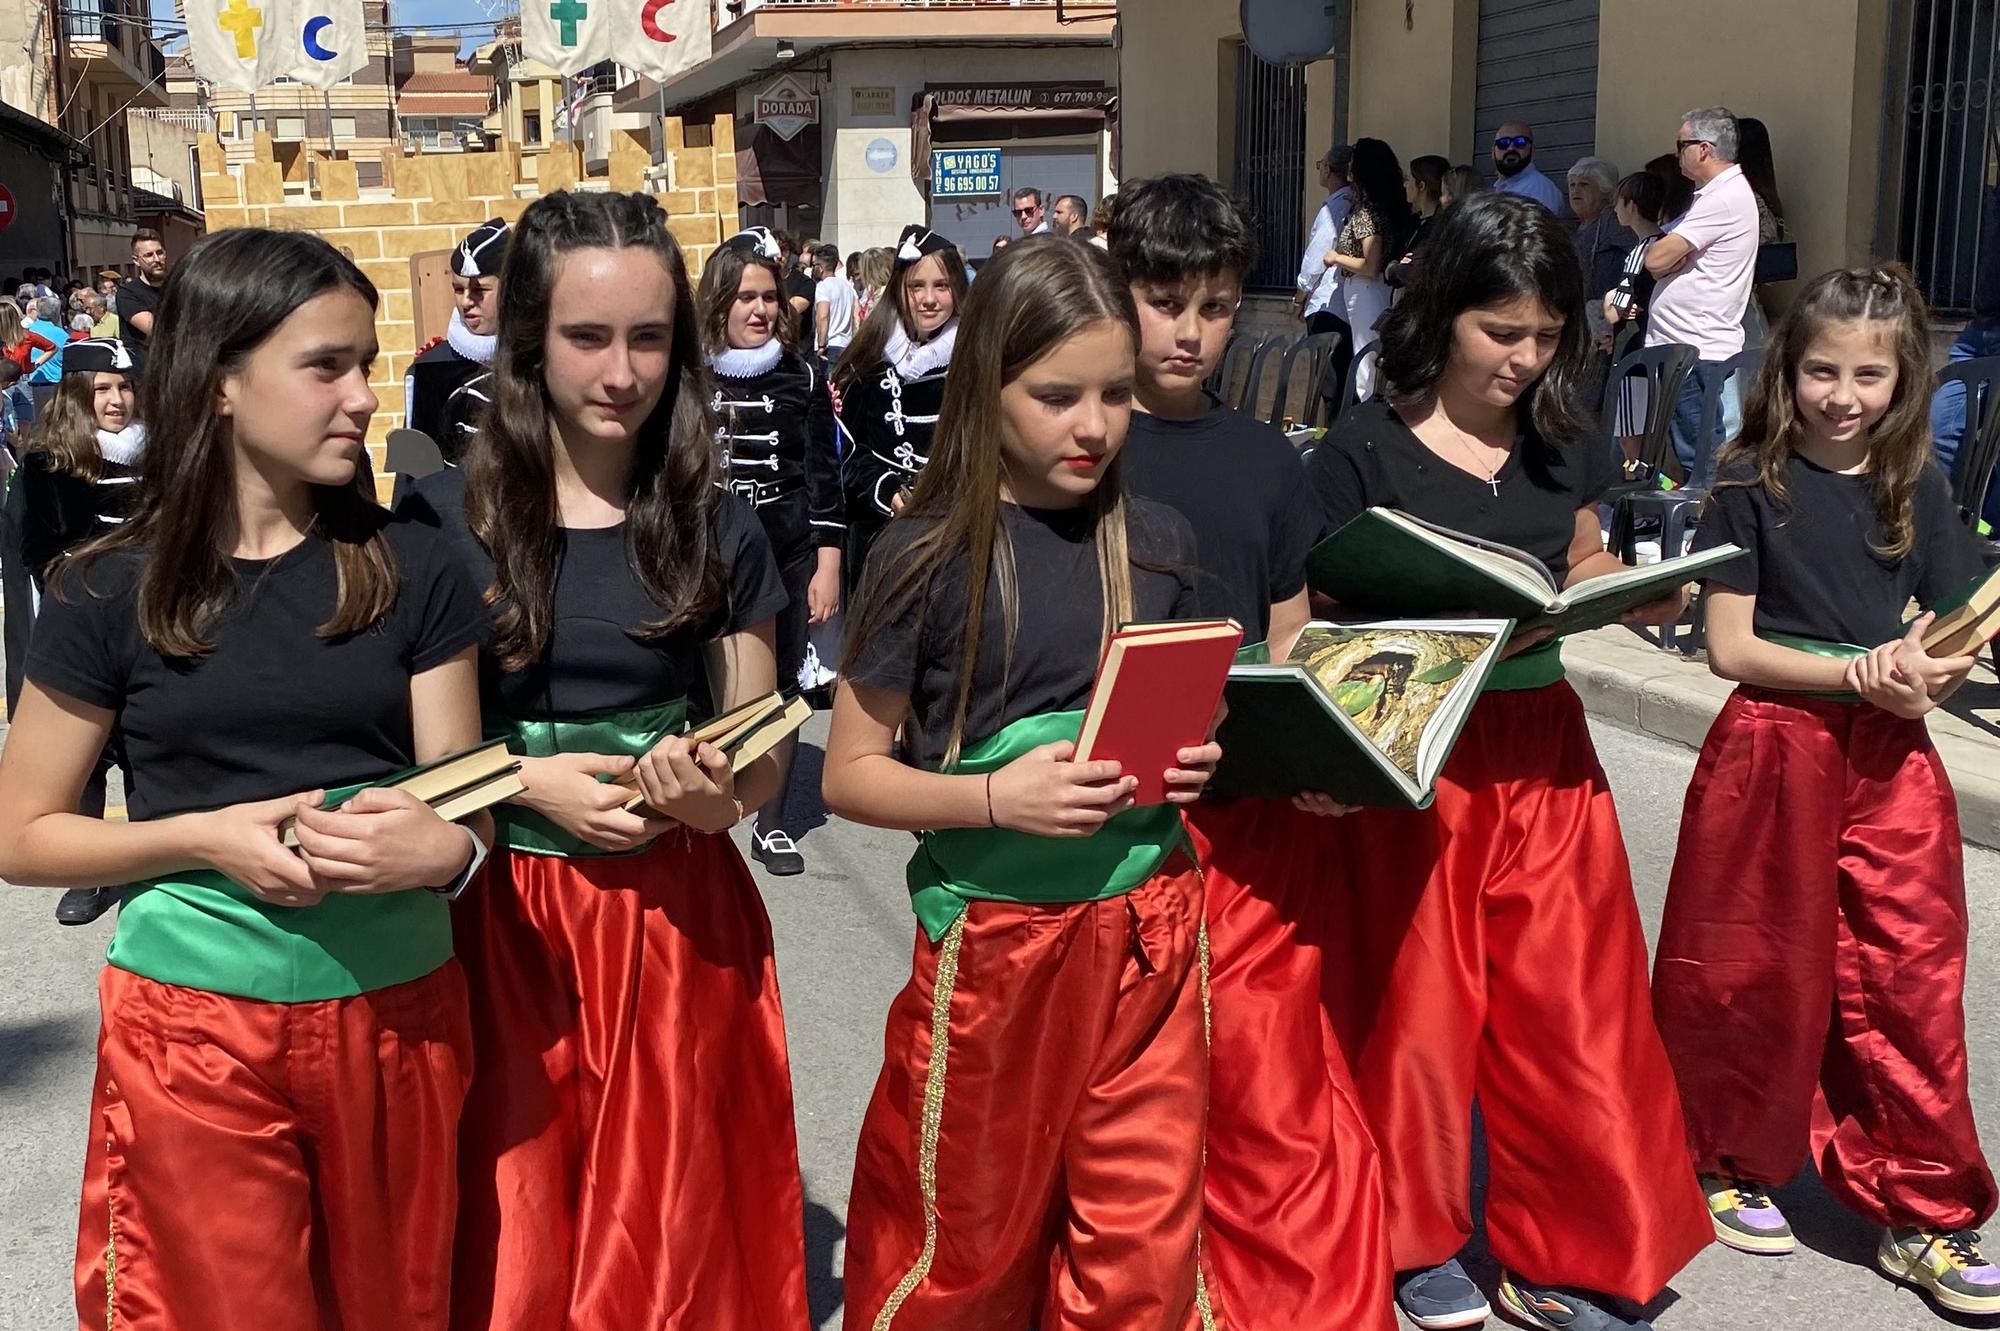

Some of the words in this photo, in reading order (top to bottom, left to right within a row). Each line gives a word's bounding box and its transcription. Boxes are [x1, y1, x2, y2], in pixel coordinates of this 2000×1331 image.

[929, 89, 972, 104] OLDOS
[974, 89, 1031, 104] METALUN
[762, 102, 812, 114] DORADA
[957, 153, 997, 169] YAGO'S
[944, 177, 955, 192] 96
[957, 176, 974, 191] 695
[975, 175, 987, 191] 00
[988, 175, 999, 190] 57
